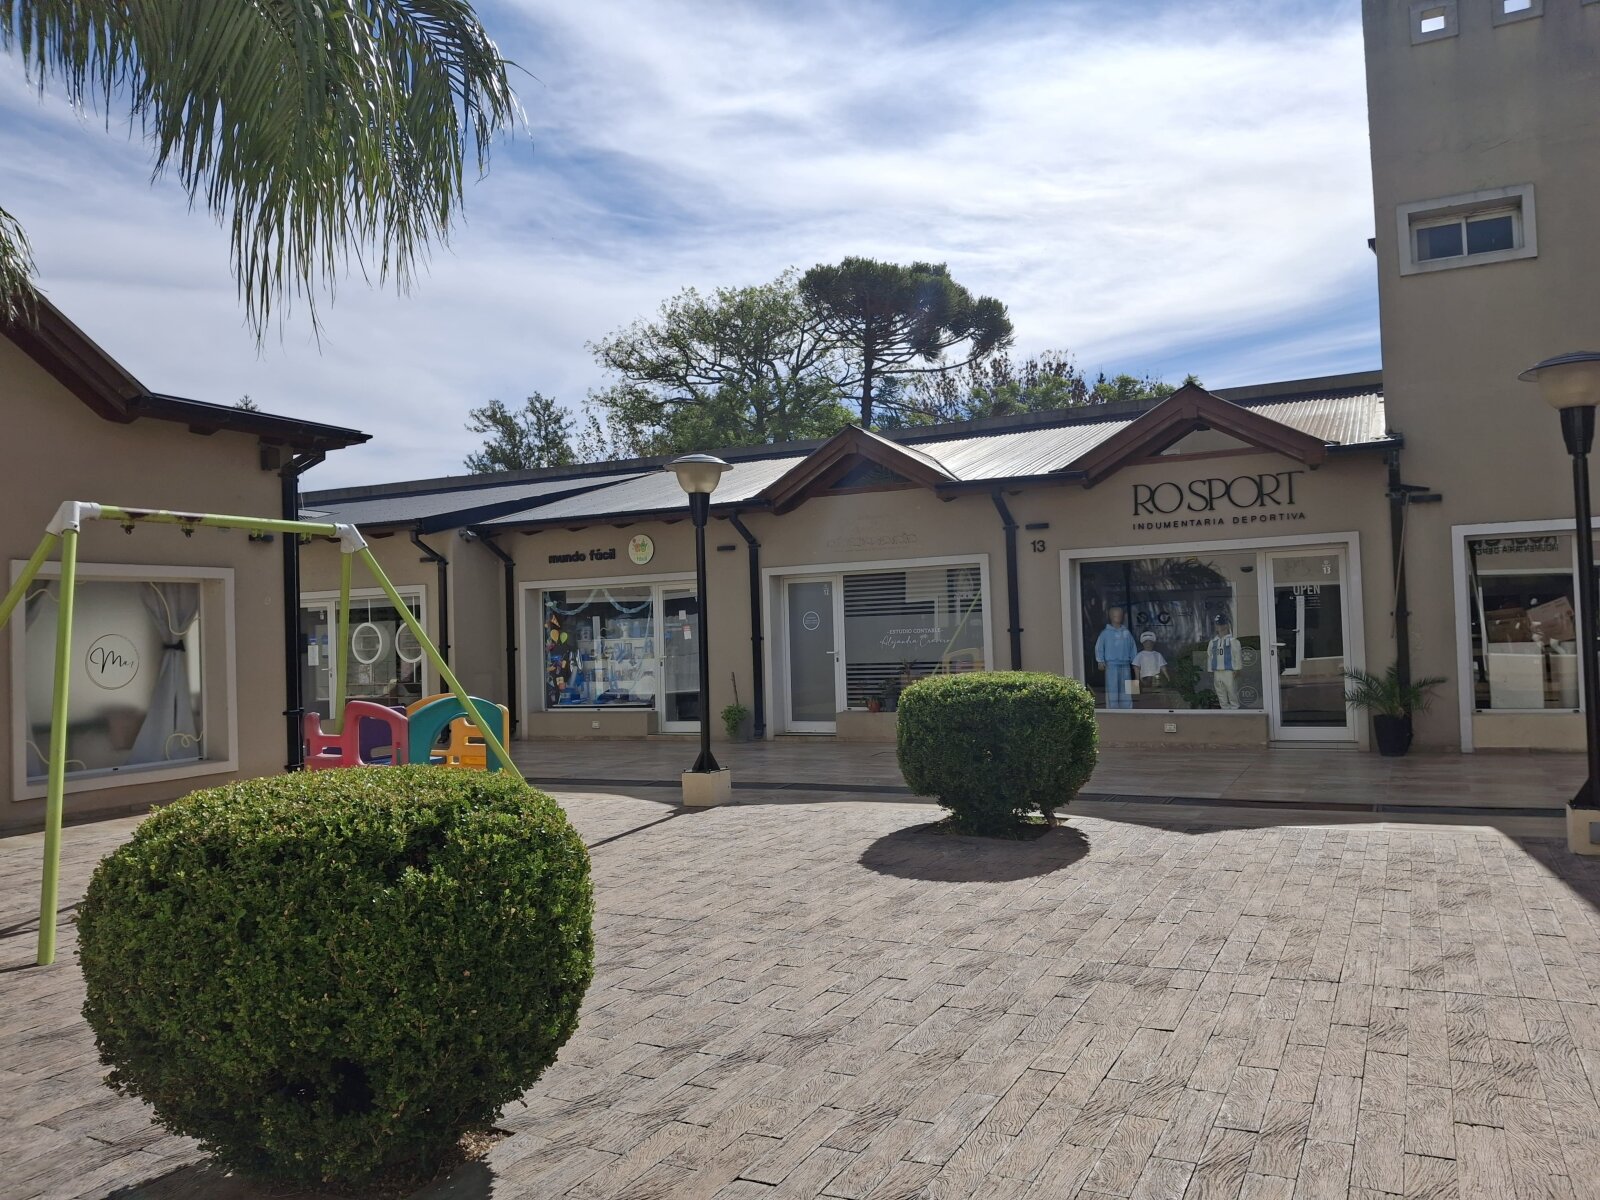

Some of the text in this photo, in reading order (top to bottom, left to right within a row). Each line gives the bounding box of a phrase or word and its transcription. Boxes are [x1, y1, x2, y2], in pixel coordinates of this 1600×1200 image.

[1132, 512, 1306, 530] INDUMENTARIA DEPORTIVA
[1030, 539, 1046, 553] 13
[548, 548, 616, 564] mundo fácil
[1322, 566, 1331, 575] 13
[1293, 584, 1321, 596] OPEN
